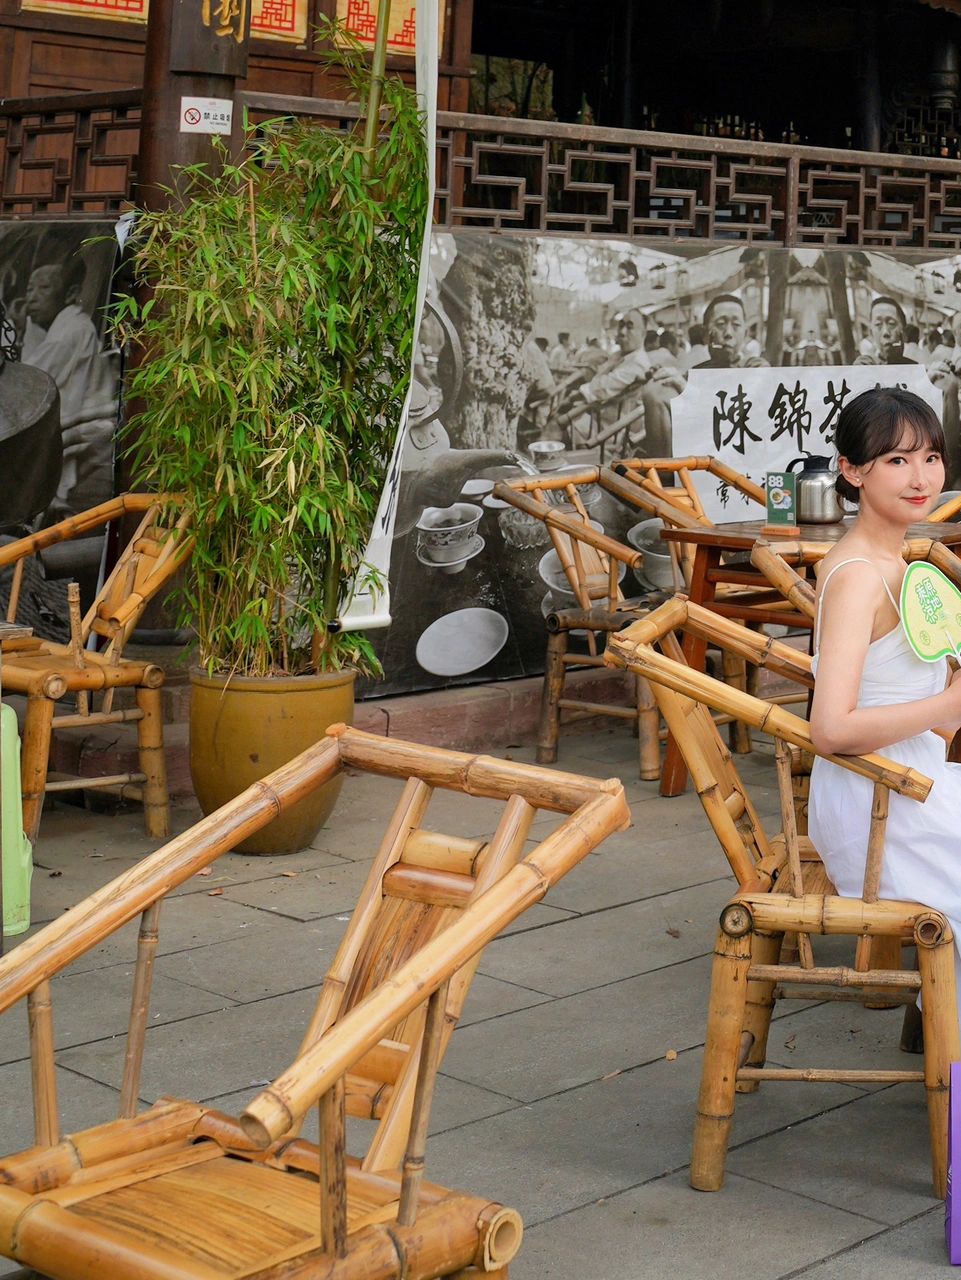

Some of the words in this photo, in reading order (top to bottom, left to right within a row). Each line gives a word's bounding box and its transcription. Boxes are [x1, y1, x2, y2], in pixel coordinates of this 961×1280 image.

[712, 378, 908, 456] 陳錦茶
[768, 475, 785, 488] 88
